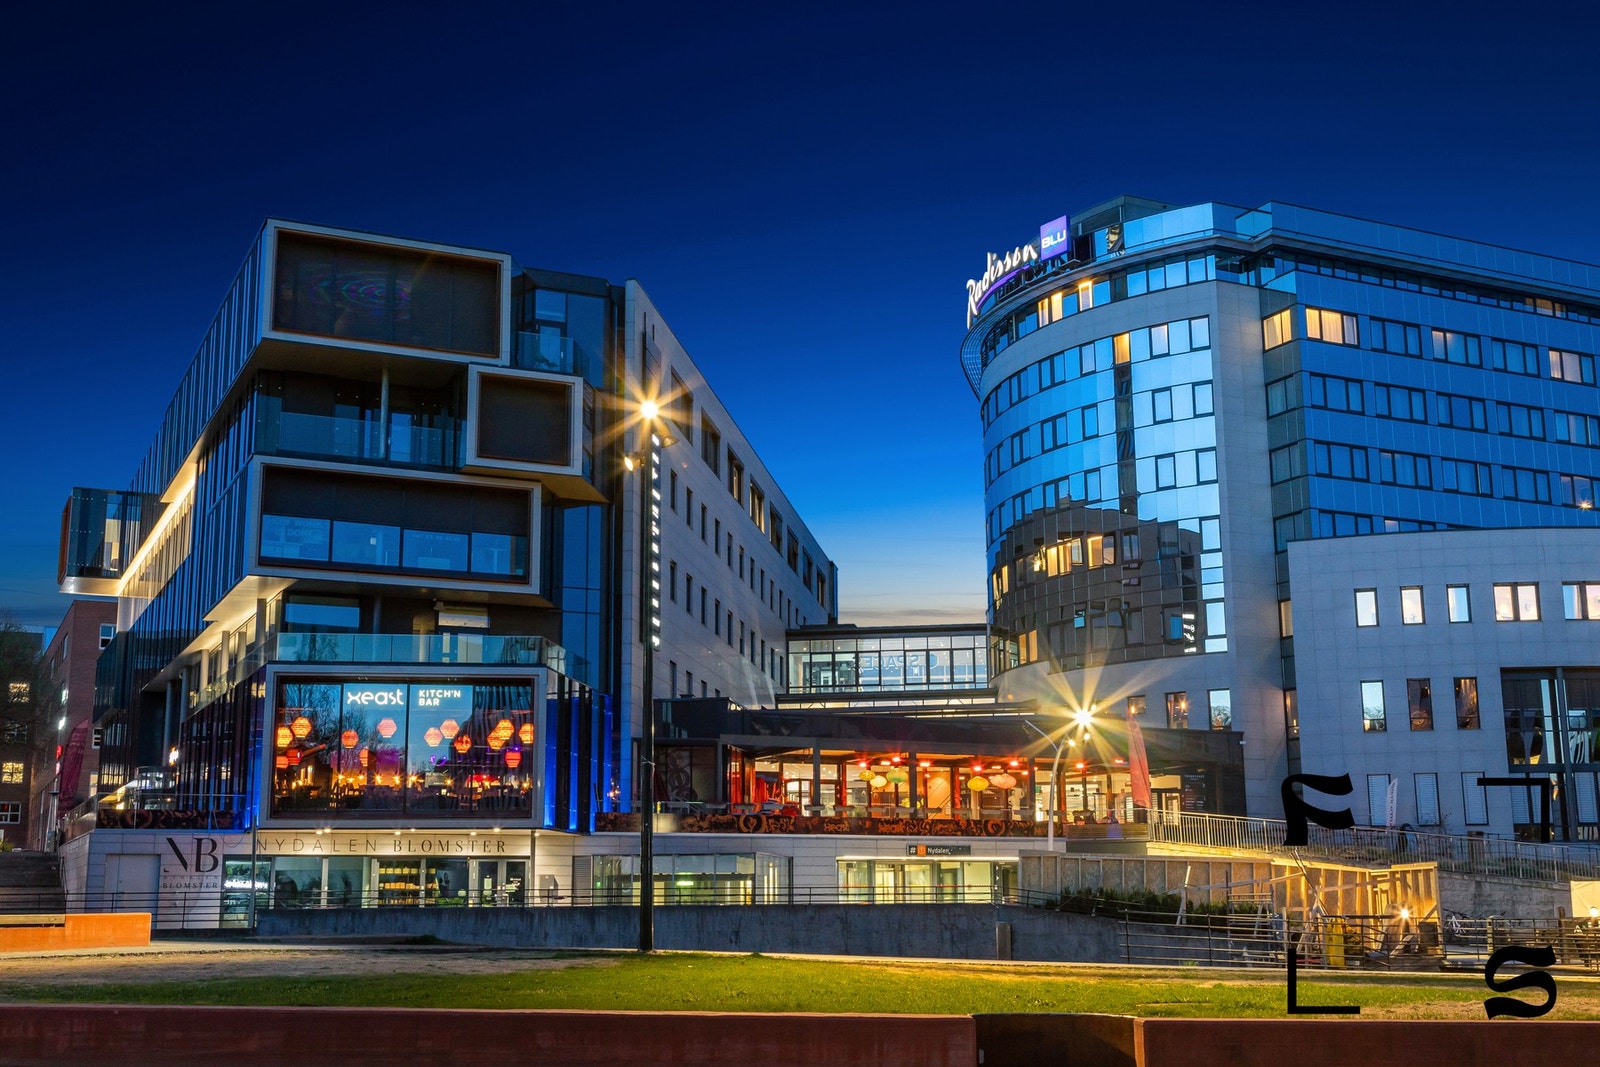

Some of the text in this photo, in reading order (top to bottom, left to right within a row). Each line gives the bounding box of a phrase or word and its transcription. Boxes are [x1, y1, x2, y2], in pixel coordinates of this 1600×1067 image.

[1041, 229, 1067, 249] BLU
[966, 244, 1038, 330] Radisson
[346, 688, 404, 705] xeast
[418, 689, 461, 698] KITCH'N
[418, 698, 440, 706] BAR
[256, 838, 505, 853] NYDALEN BLOMSTER
[163, 837, 219, 873] NB
